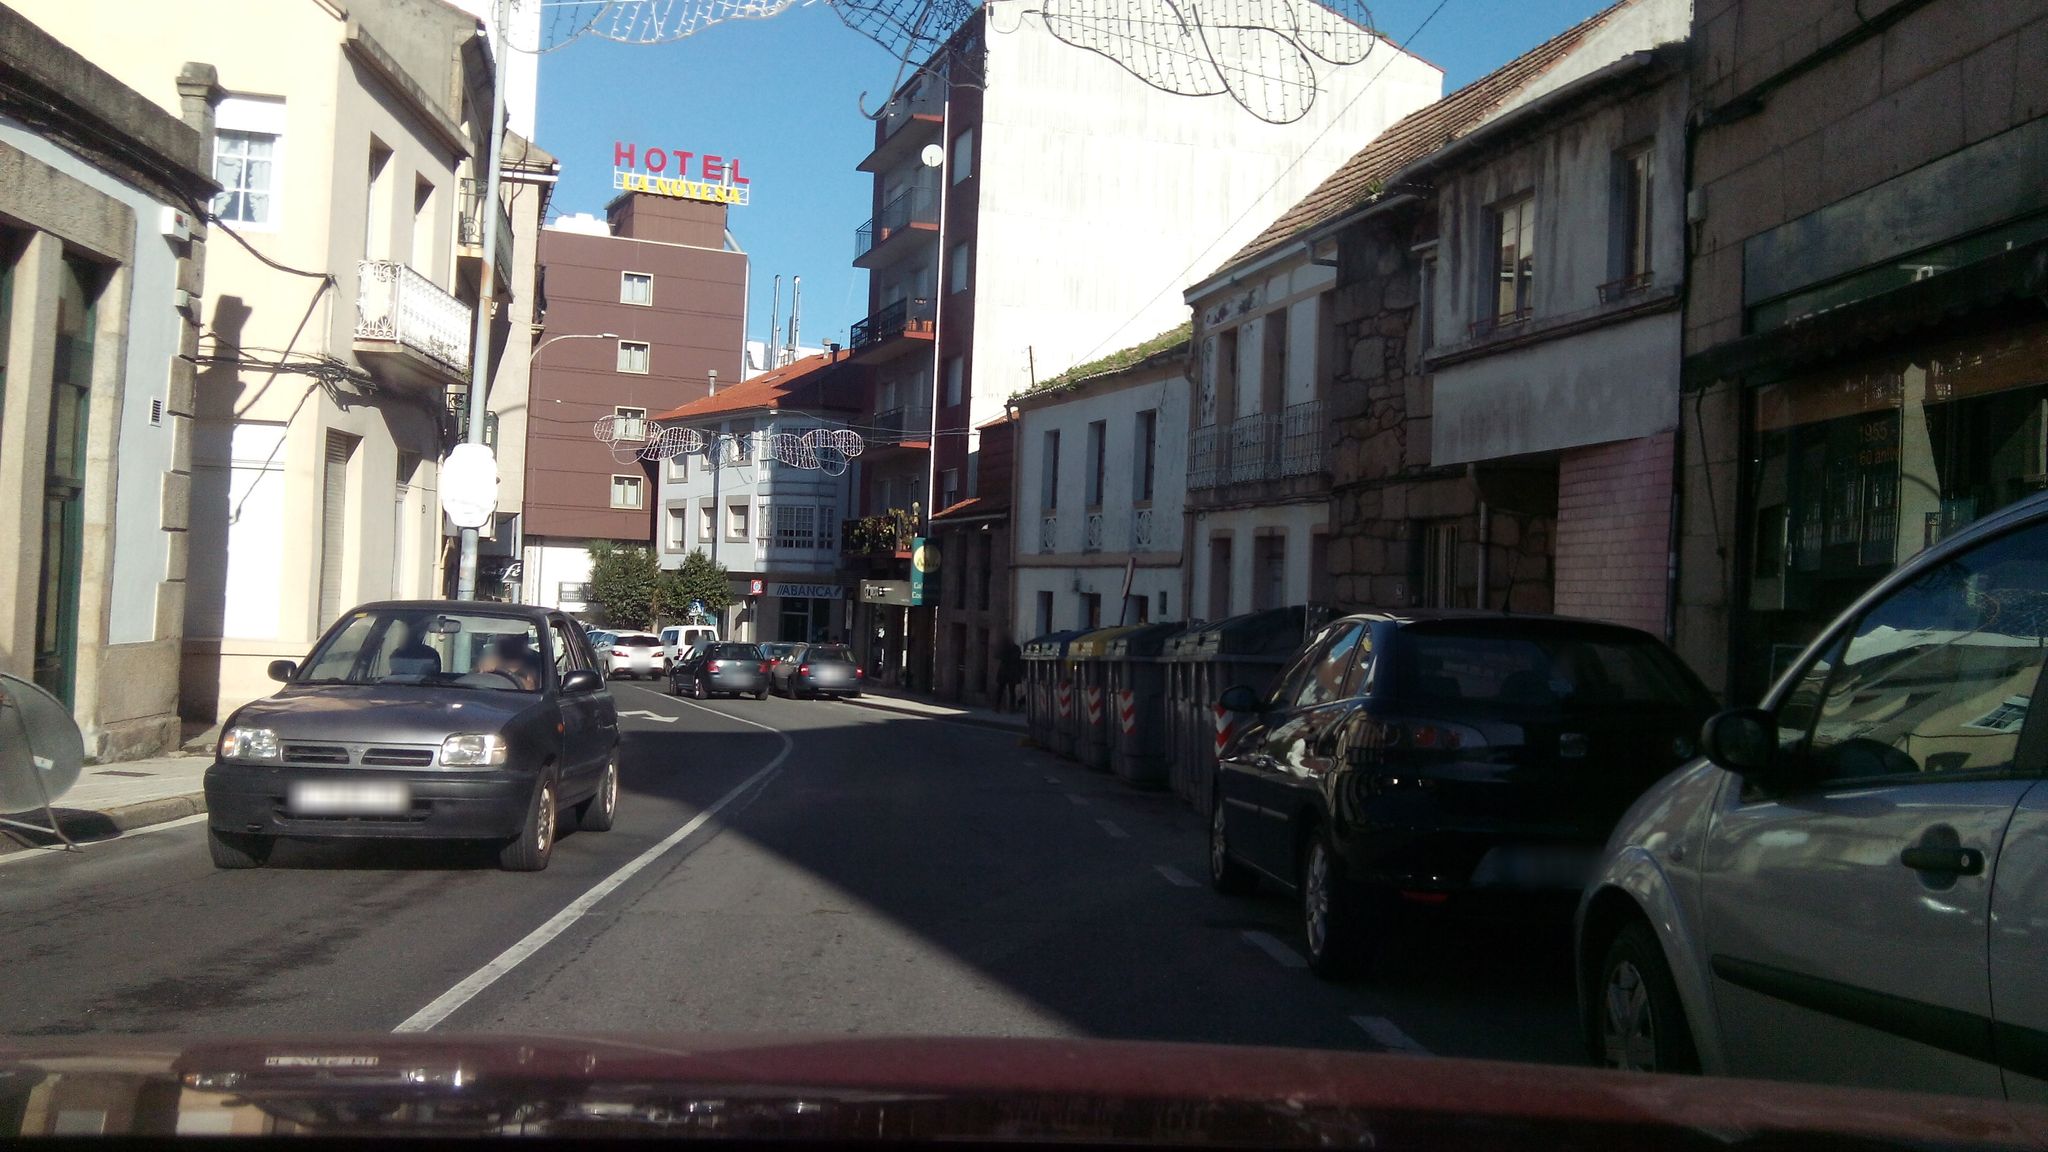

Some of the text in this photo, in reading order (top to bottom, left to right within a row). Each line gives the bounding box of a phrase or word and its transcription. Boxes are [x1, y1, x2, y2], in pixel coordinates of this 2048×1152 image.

[614, 141, 750, 184] HOTEL
[622, 172, 741, 204] LA NOYESA
[782, 585, 833, 597] ABANCA
